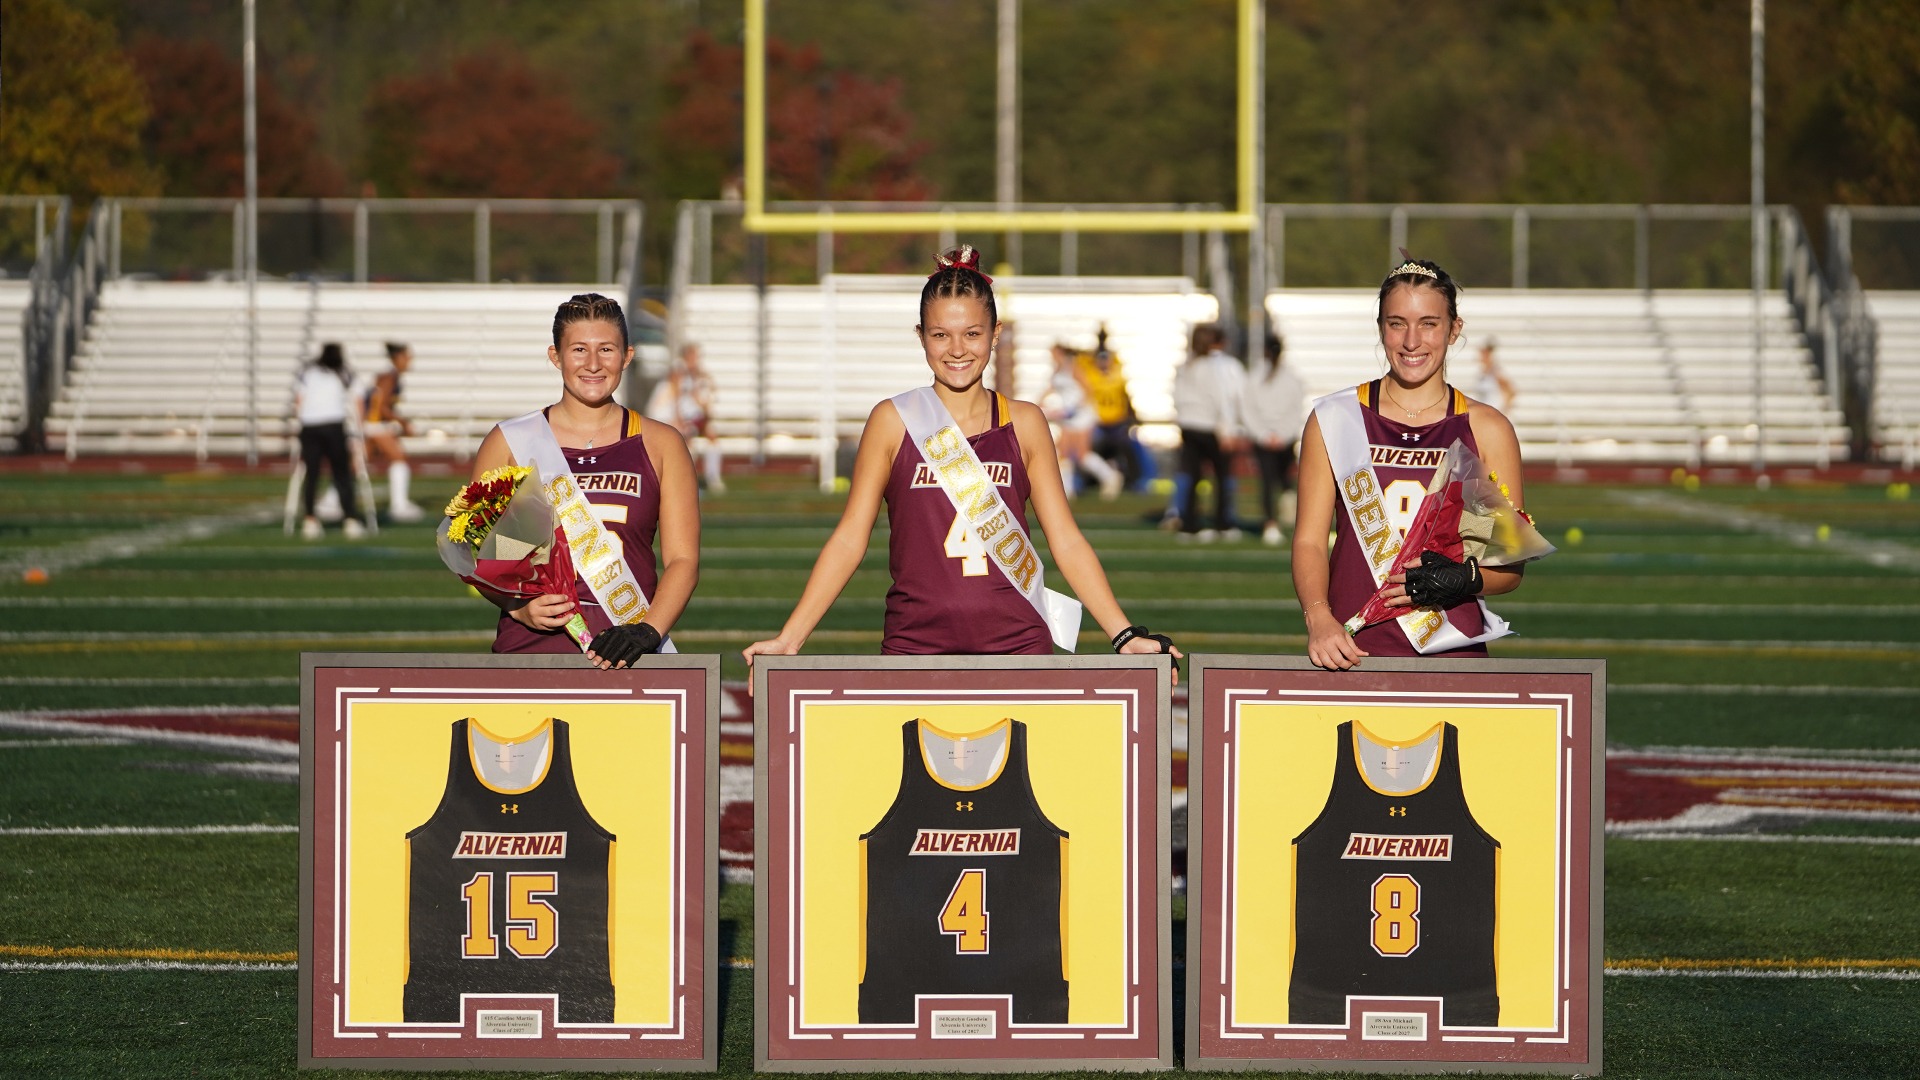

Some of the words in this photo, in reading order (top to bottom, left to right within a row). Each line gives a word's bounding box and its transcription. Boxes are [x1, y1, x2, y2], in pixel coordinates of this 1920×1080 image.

[943, 511, 990, 577] 4
[458, 834, 564, 857] ALVERNIA
[915, 831, 1018, 853] ALVERNIA
[1347, 835, 1451, 858] ALVERNIA
[461, 871, 559, 960] 15
[937, 868, 990, 955] 4
[1370, 873, 1421, 958] 8
